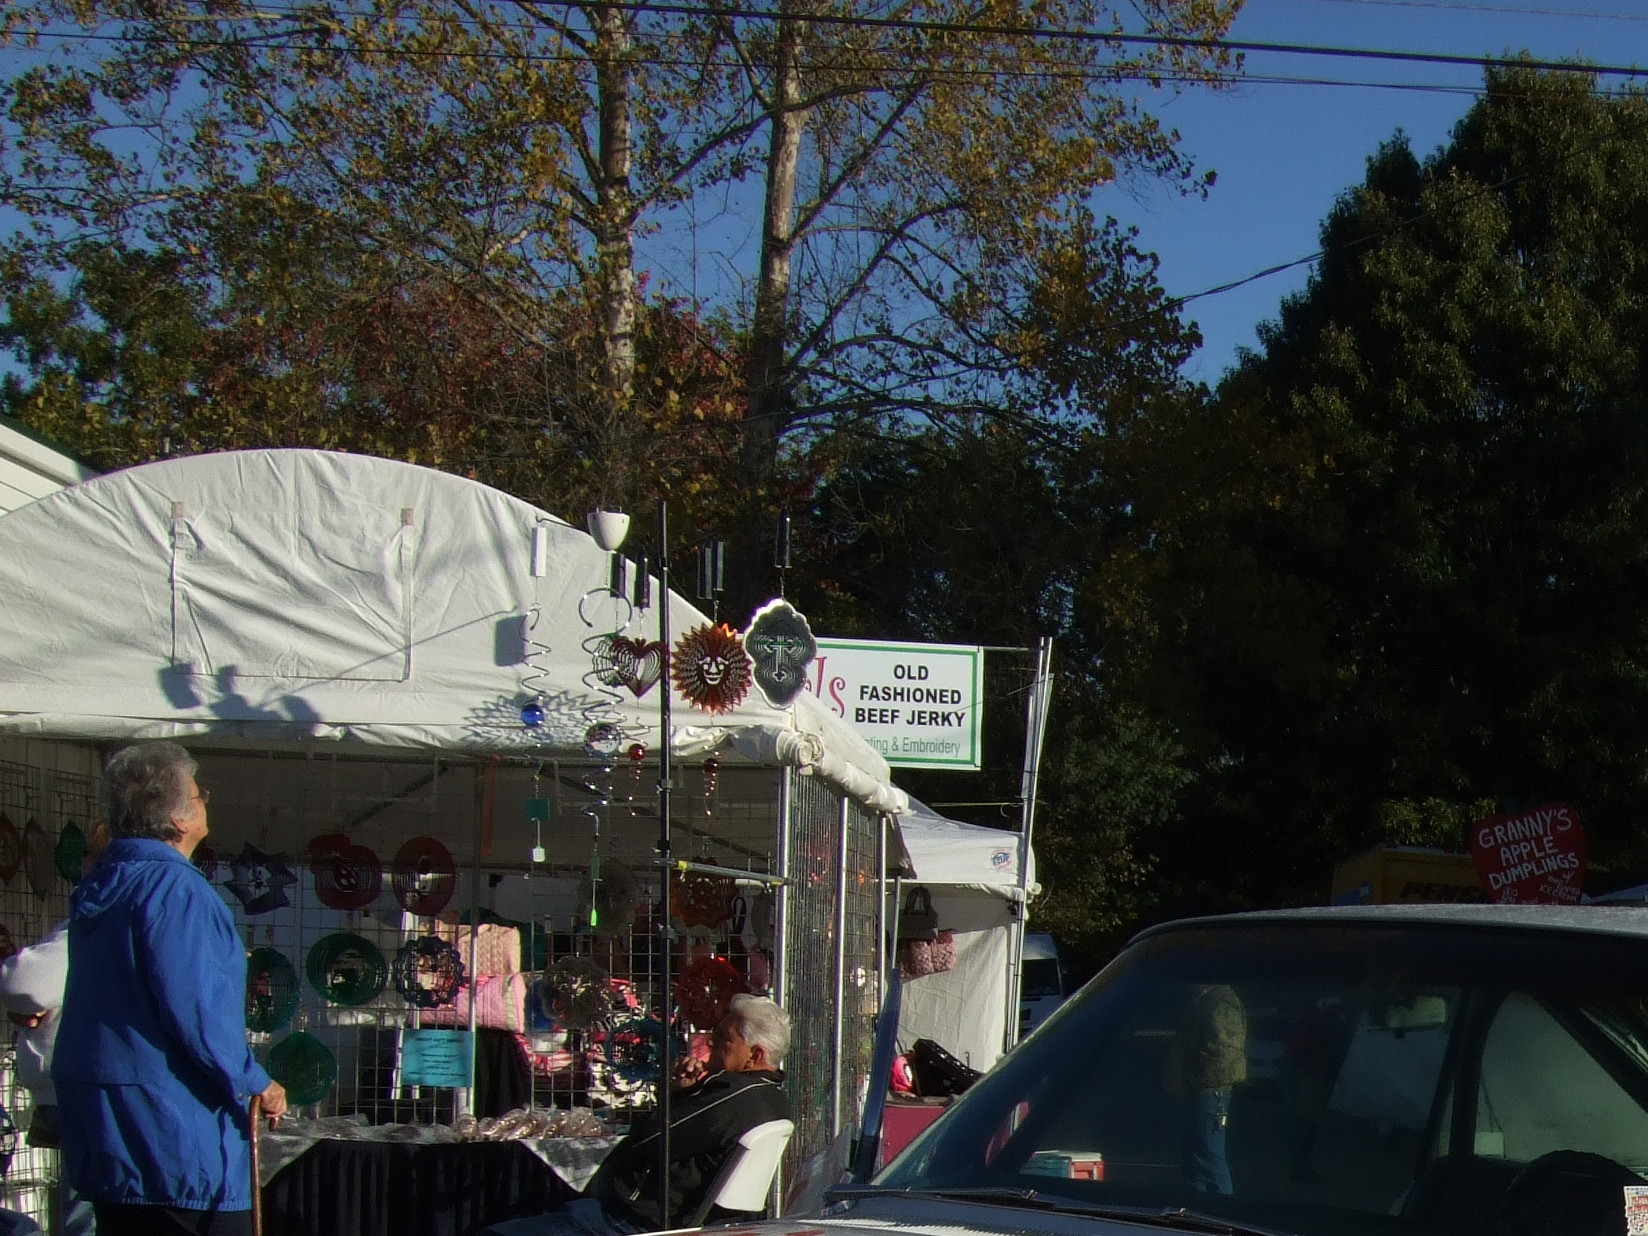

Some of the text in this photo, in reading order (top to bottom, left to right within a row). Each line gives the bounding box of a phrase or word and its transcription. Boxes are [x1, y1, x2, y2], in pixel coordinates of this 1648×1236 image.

[893, 664, 929, 680] OLD
[859, 684, 962, 704] FASHIONED
[855, 707, 966, 727] BEEF JERKY
[891, 736, 899, 752] &
[902, 736, 961, 757] Embroidery
[1478, 808, 1573, 849] GRANNY'S
[1500, 835, 1560, 867] APPLE
[1488, 852, 1580, 890] DUMPLINGS
